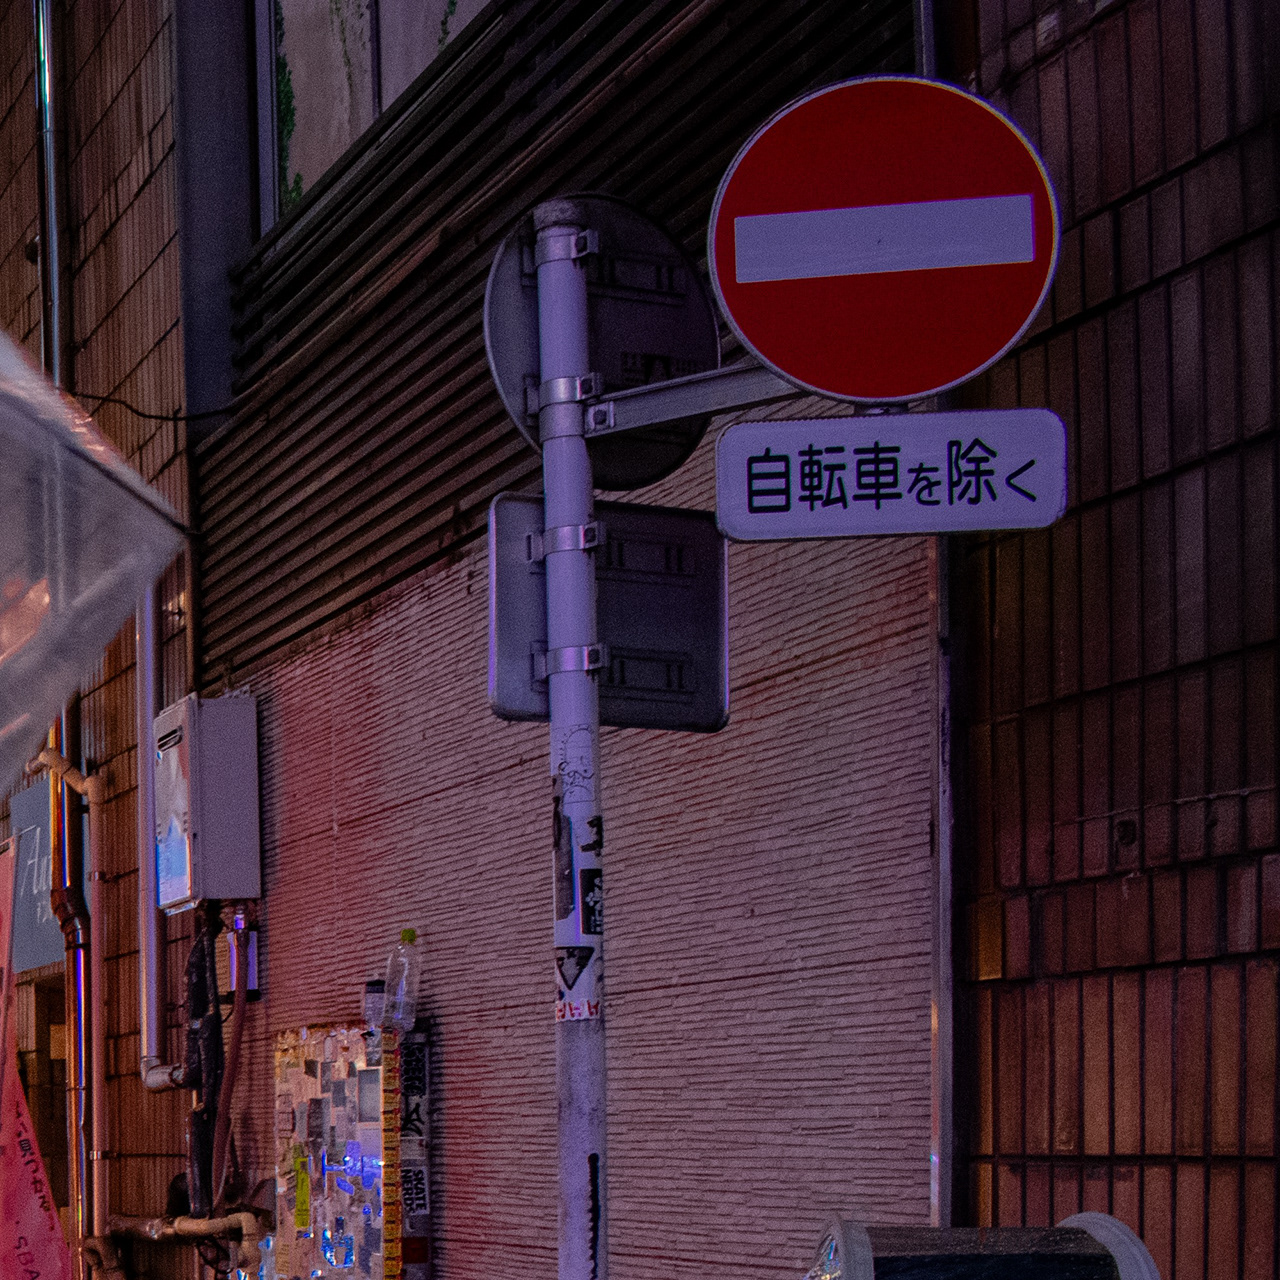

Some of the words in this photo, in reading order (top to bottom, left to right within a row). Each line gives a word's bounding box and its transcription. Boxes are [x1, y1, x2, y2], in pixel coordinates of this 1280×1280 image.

[745, 437, 1037, 516] 自転車を除く
[412, 1169, 426, 1212] SKATE
